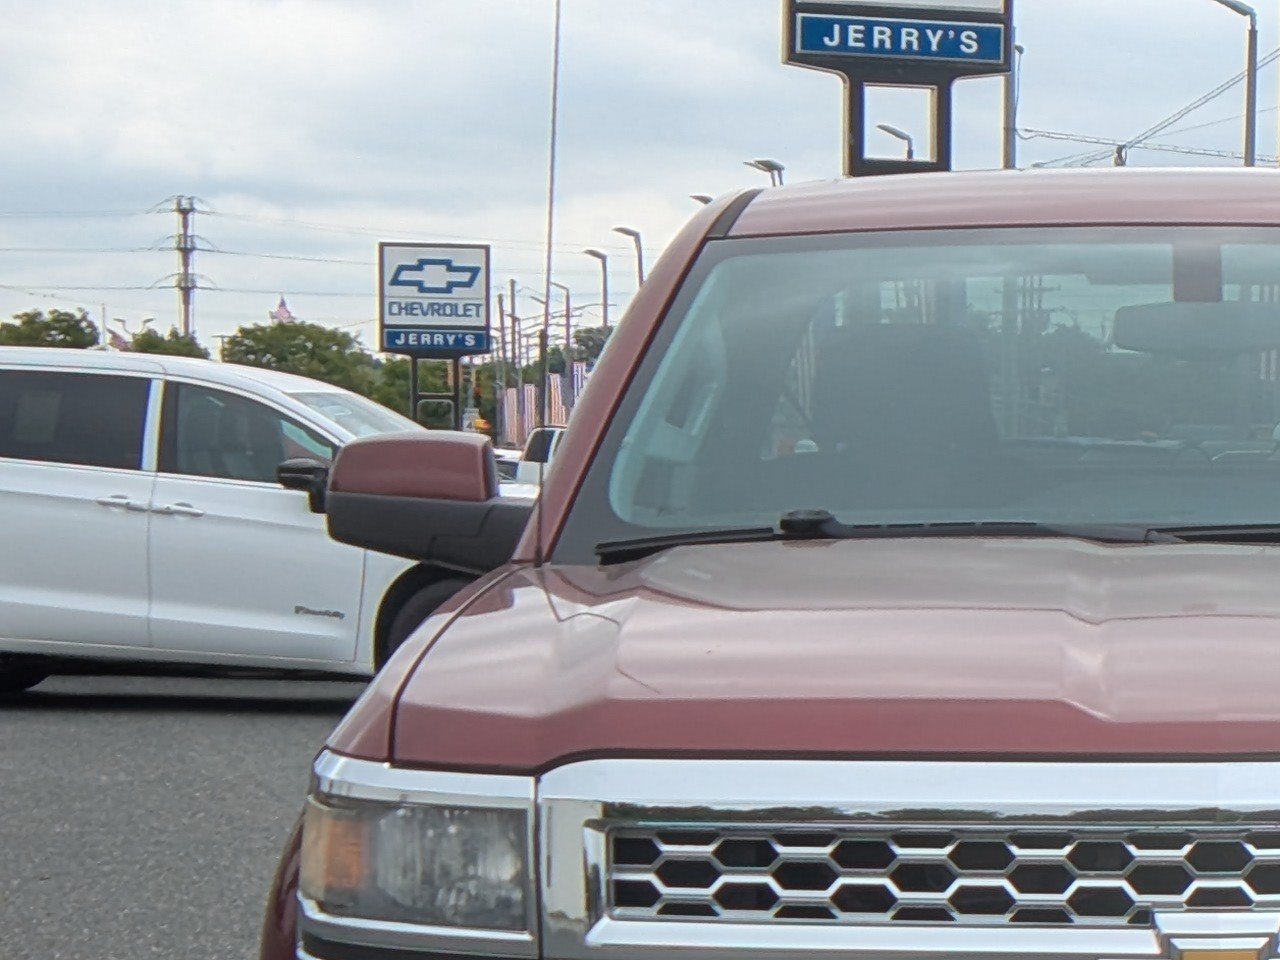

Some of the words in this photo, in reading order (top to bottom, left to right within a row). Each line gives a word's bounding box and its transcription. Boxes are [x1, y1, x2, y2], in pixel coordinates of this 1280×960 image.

[823, 24, 979, 54] JERRY'S
[389, 302, 482, 317] CHEVROLET
[395, 333, 476, 347] JERRY'S
